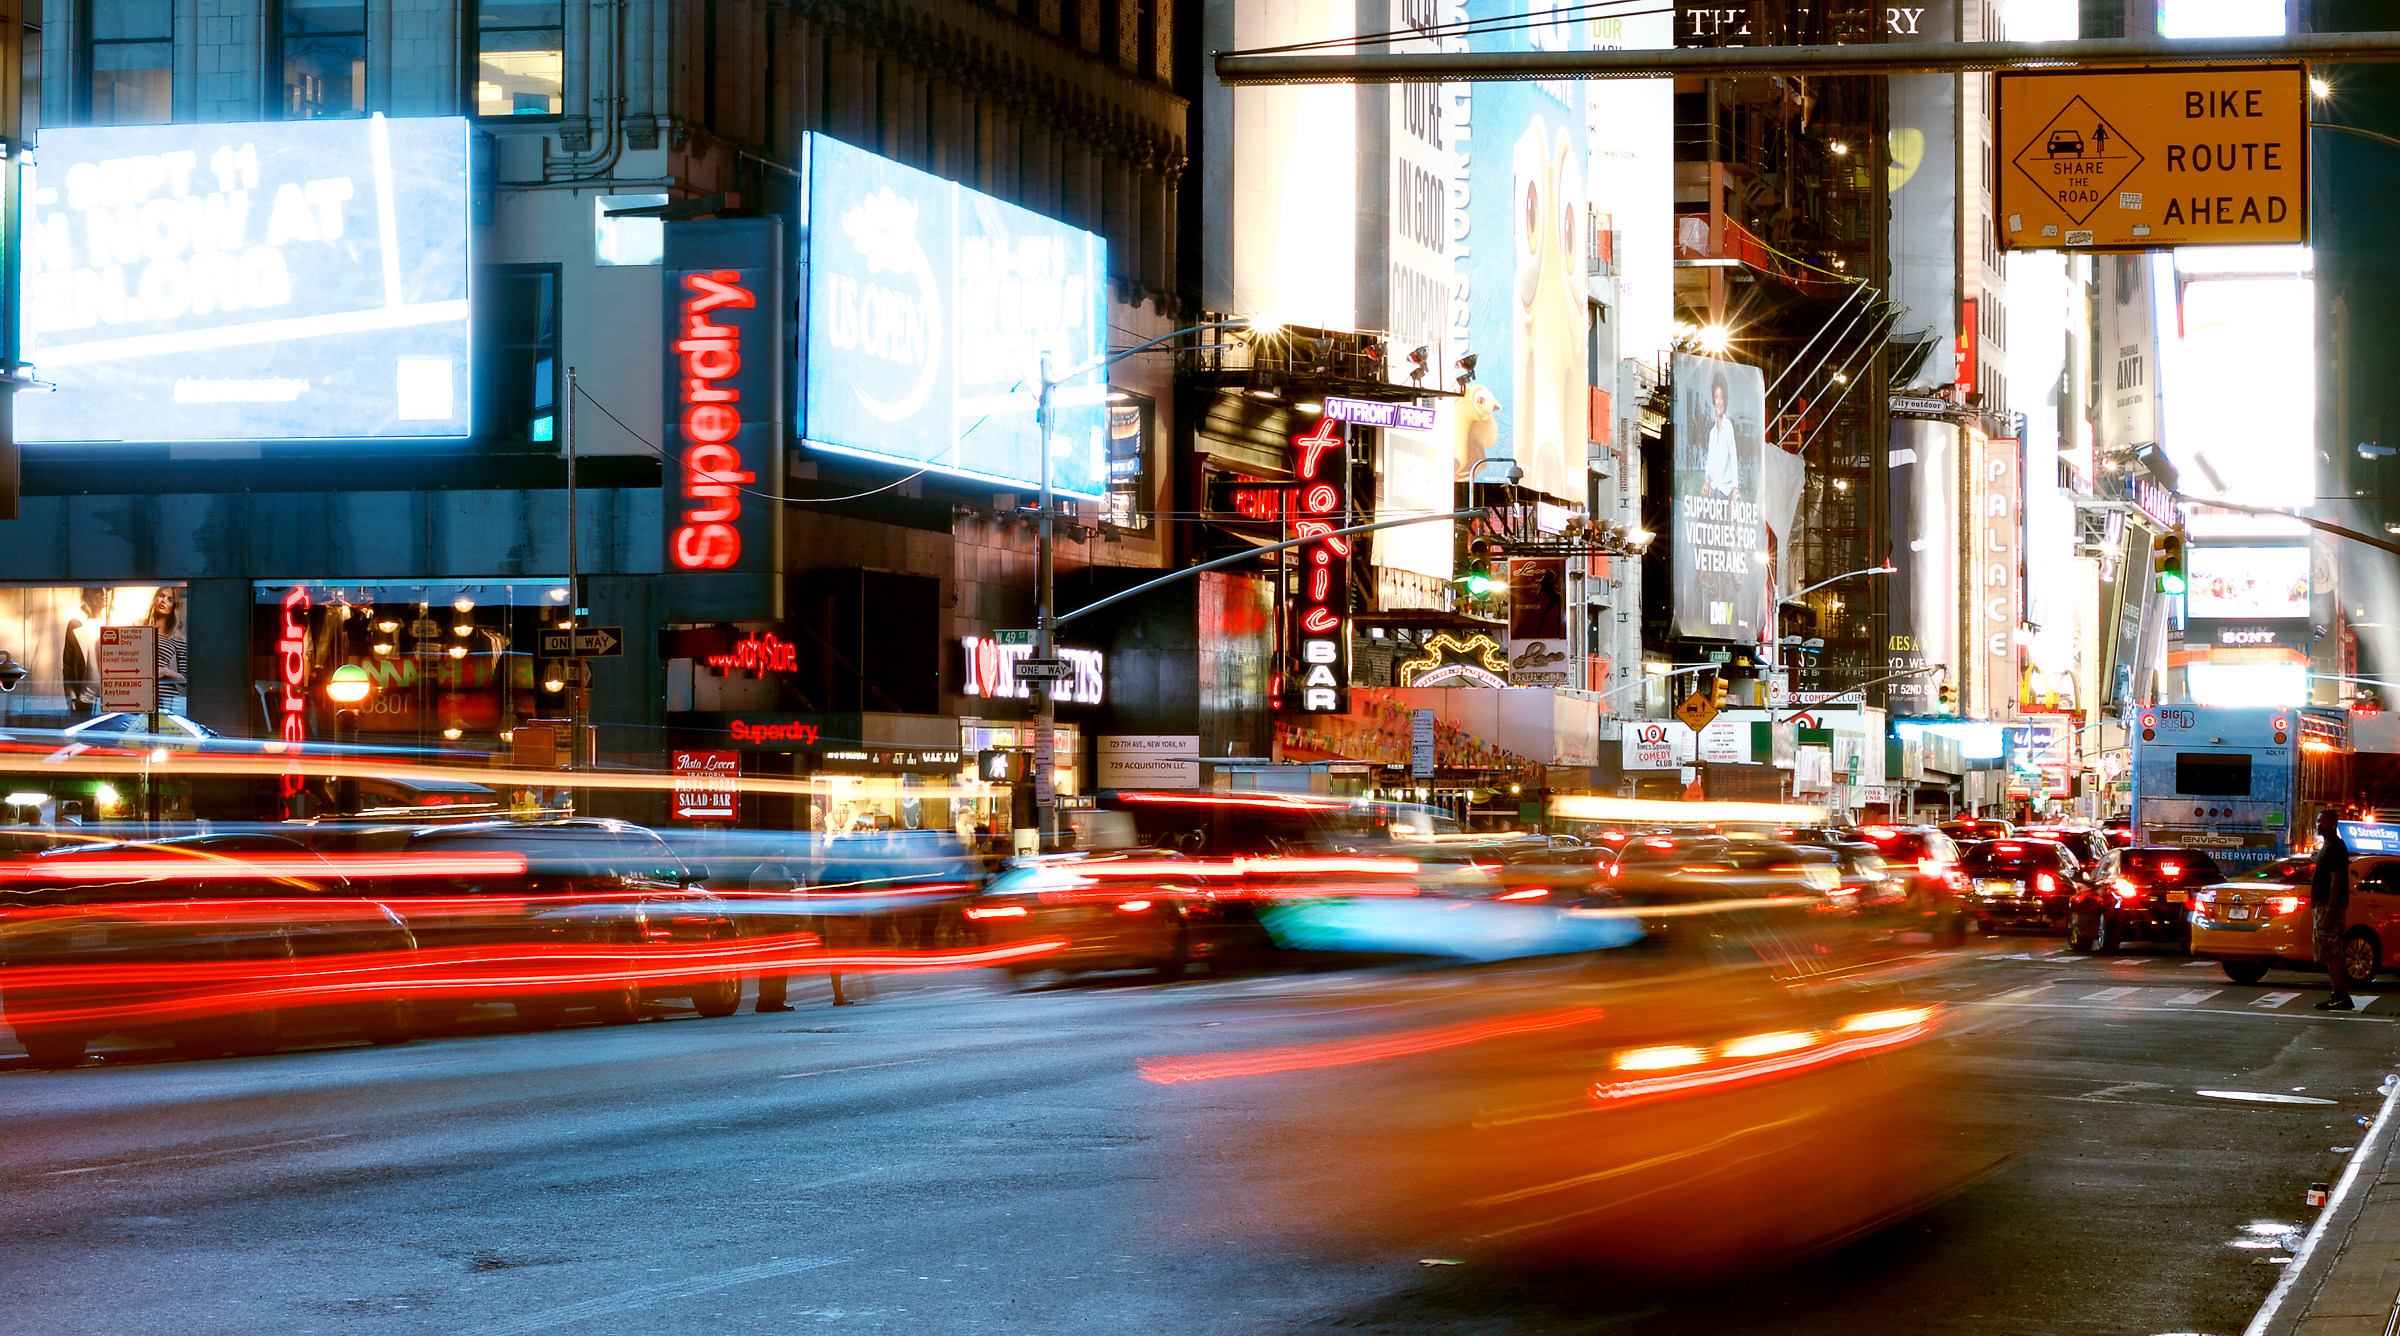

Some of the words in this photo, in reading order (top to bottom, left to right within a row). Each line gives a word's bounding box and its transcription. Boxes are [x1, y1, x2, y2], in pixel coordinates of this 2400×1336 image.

[2186, 89, 2262, 118] BIKE
[2167, 143, 2281, 172] ROUTE
[2054, 162, 2104, 174] SHARE
[66, 150, 196, 210] SEPT
[210, 141, 260, 192] 11
[2069, 178, 2088, 187] THE
[2059, 190, 2099, 202] ROAD
[1399, 156, 1411, 238] IN
[1414, 165, 1445, 254] GOOD
[2163, 196, 2287, 225] AHEAD
[86, 188, 249, 267] NOW
[266, 177, 354, 246] AT
[1391, 261, 1449, 359] COMPANY
[828, 272, 858, 350] US
[860, 281, 931, 368] OPEN
[2116, 355, 2143, 391] ANTI
[1911, 400, 1942, 410] outdoor
[1327, 404, 1394, 425] OUTFRONT
[1400, 408, 1434, 427] PRIME
[1683, 495, 1730, 521] SUPPORT
[1731, 502, 1758, 525] MORE
[1685, 521, 1736, 547] VICTORIES
[1737, 526, 1757, 550] FOR
[1694, 548, 1749, 574] VETERANS.
[1988, 458, 2008, 657] PALACE
[1710, 601, 1734, 625] DAV
[551, 637, 573, 649] ON
[585, 636, 610, 649] WAY
[996, 632, 1003, 643] W
[1005, 632, 1016, 644] 49
[2222, 631, 2276, 644] SONY
[1711, 653, 1730, 662] LAMAR
[1021, 666, 1039, 674] ONE
[1048, 666, 1067, 675] WAY
[1305, 640, 1337, 711] BAR
[280, 584, 311, 798] perdry
[1900, 683, 1922, 695] 52ND
[1836, 692, 1862, 703] CLUB
[2161, 710, 2180, 719] BIG
[2160, 719, 2179, 728] BUS
[1162, 741, 1177, 749] YORK,
[1652, 742, 1671, 751] SQUARE
[677, 754, 702, 770] Pasta
[704, 755, 736, 770] Lovers
[1639, 751, 1671, 762] COMEDY
[1656, 759, 1673, 767] CLUB
[1125, 762, 1172, 770] ACQUISITION
[2357, 827, 2399, 841] StreetEasy
[2208, 852, 2276, 861] OBSERVATORY
